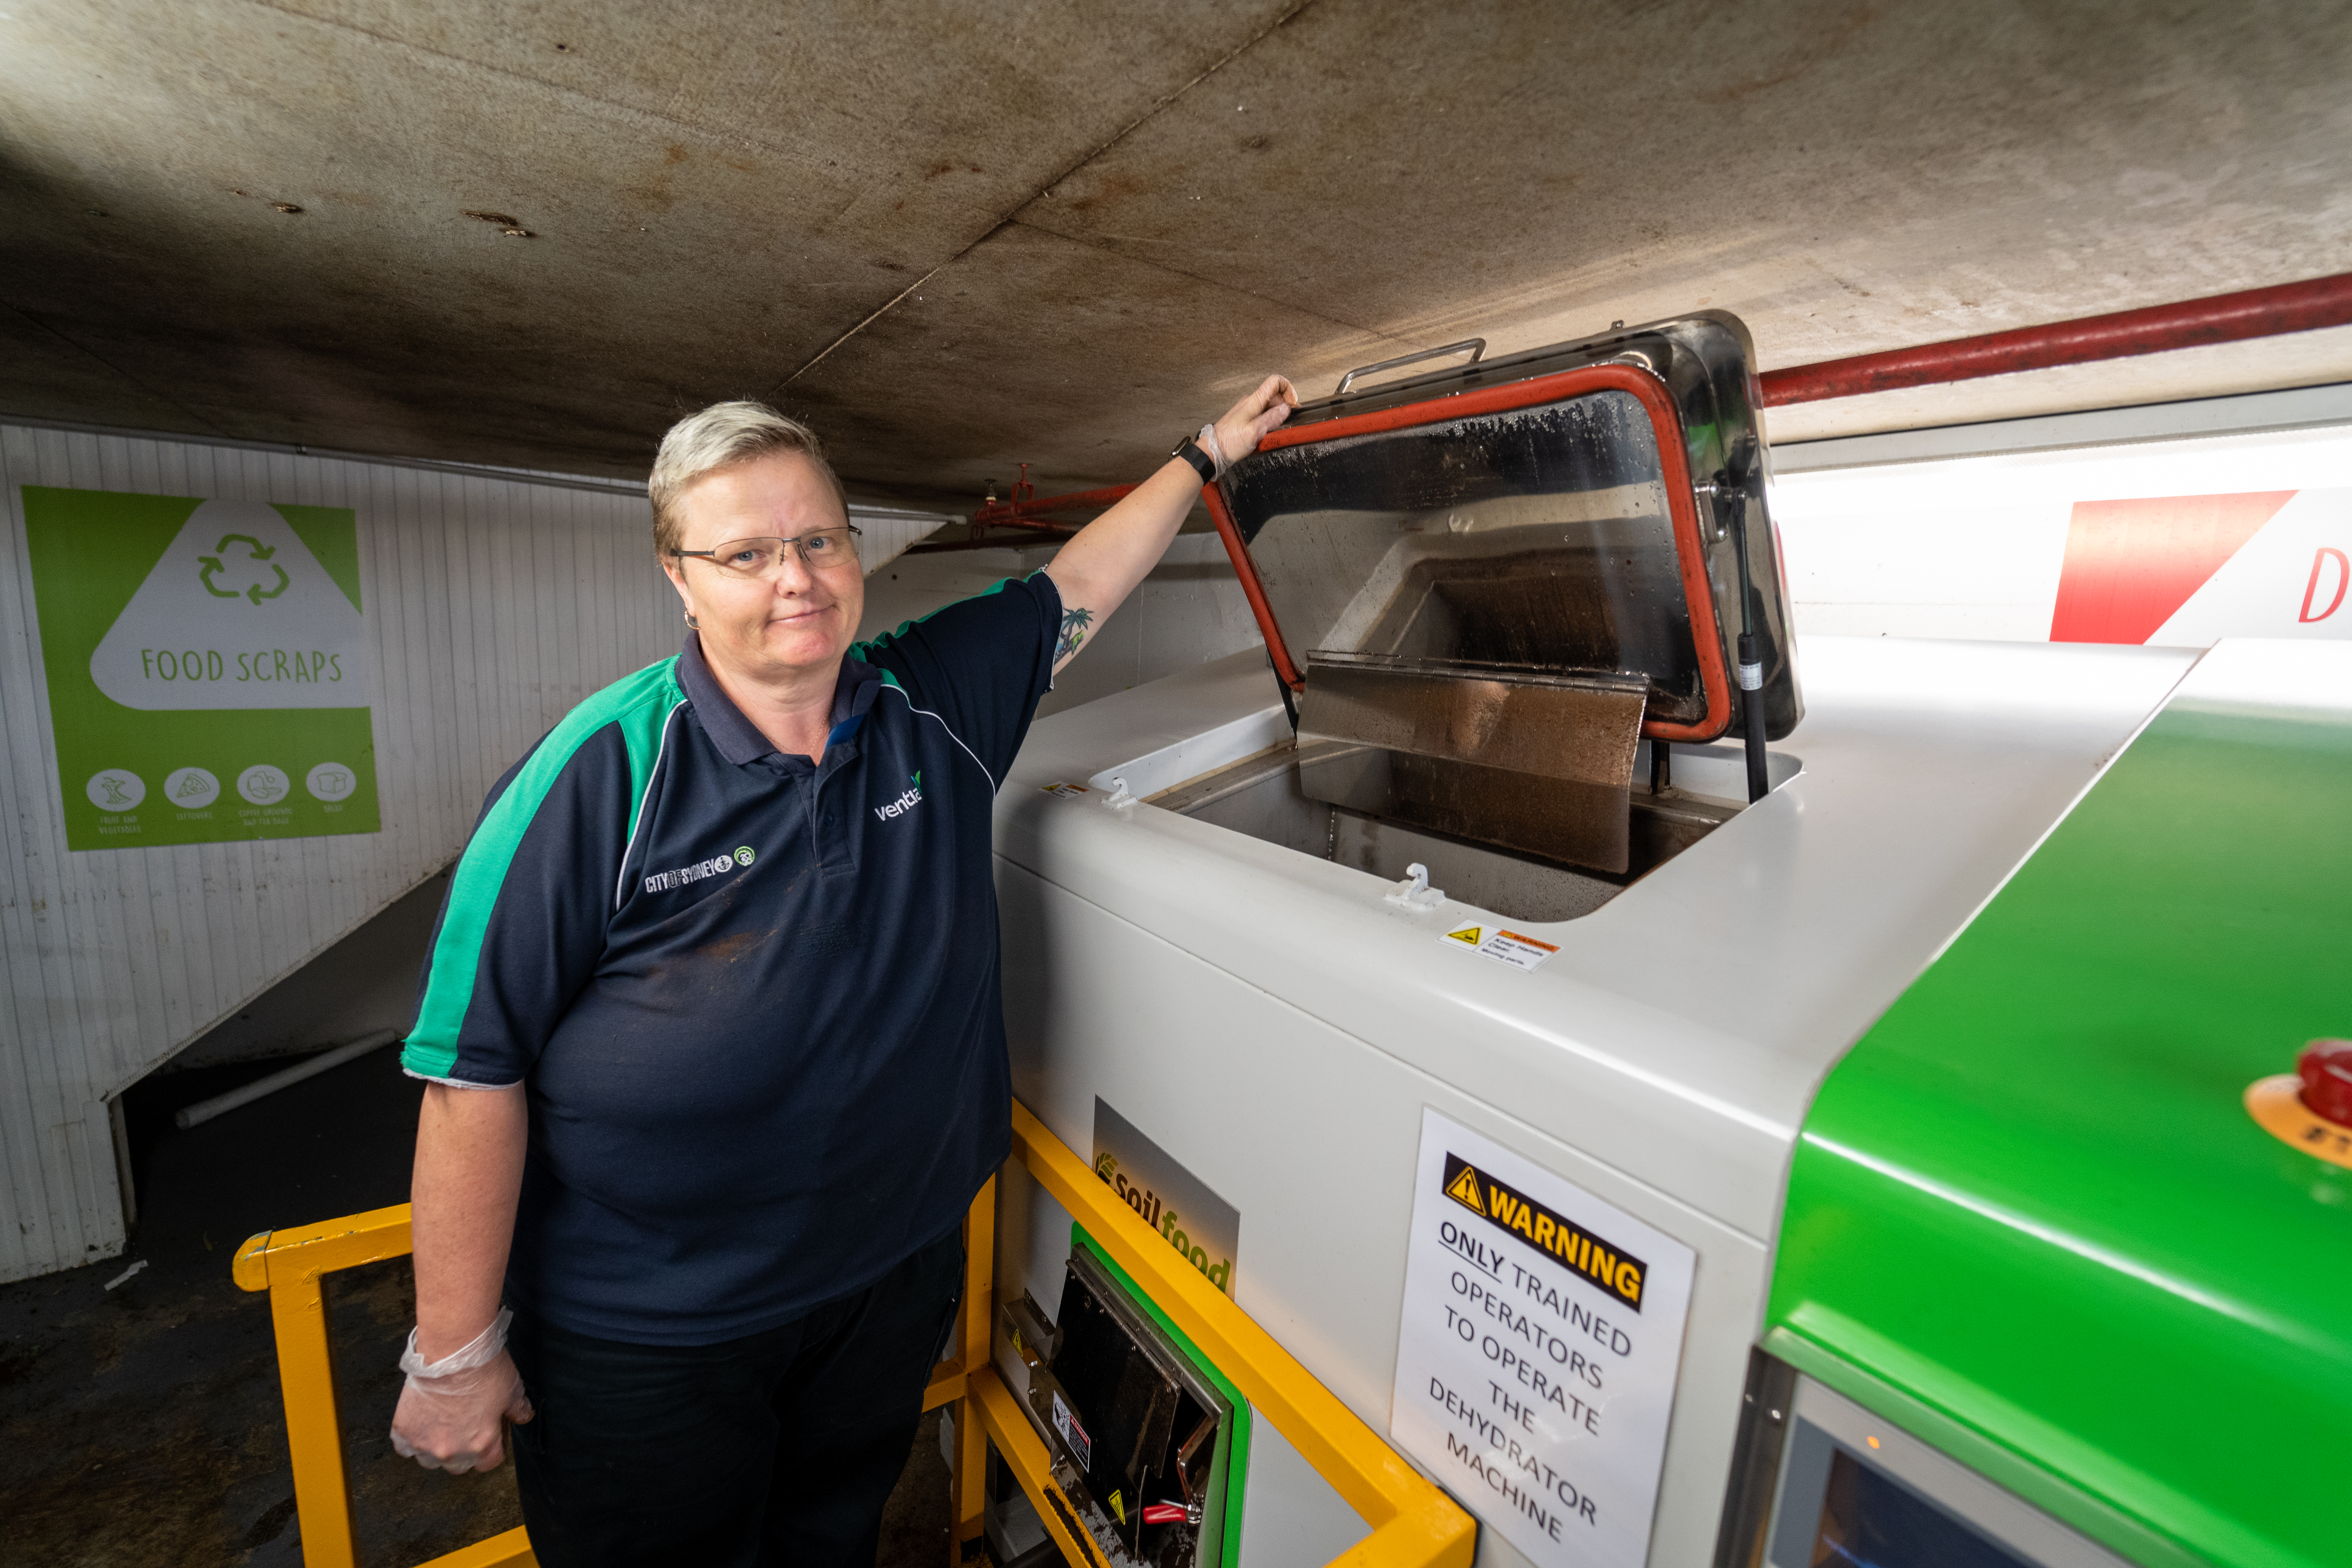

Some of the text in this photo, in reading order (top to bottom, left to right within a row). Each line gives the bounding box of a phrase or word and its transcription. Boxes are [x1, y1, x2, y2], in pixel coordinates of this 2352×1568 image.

[142, 649, 342, 683] FOOD SCRAPS
[1441, 1221, 1632, 1357] ONLY TRAINED
[1490, 1185, 1641, 1302] WARNING
[1444, 1305, 1601, 1437] TO OPERATE
[1451, 1271, 1603, 1390] OPERATORS
[1430, 1377, 1596, 1527] DEHYDRATOR
[1488, 1379, 1534, 1434] THE
[1447, 1432, 1563, 1544] MACHINE
